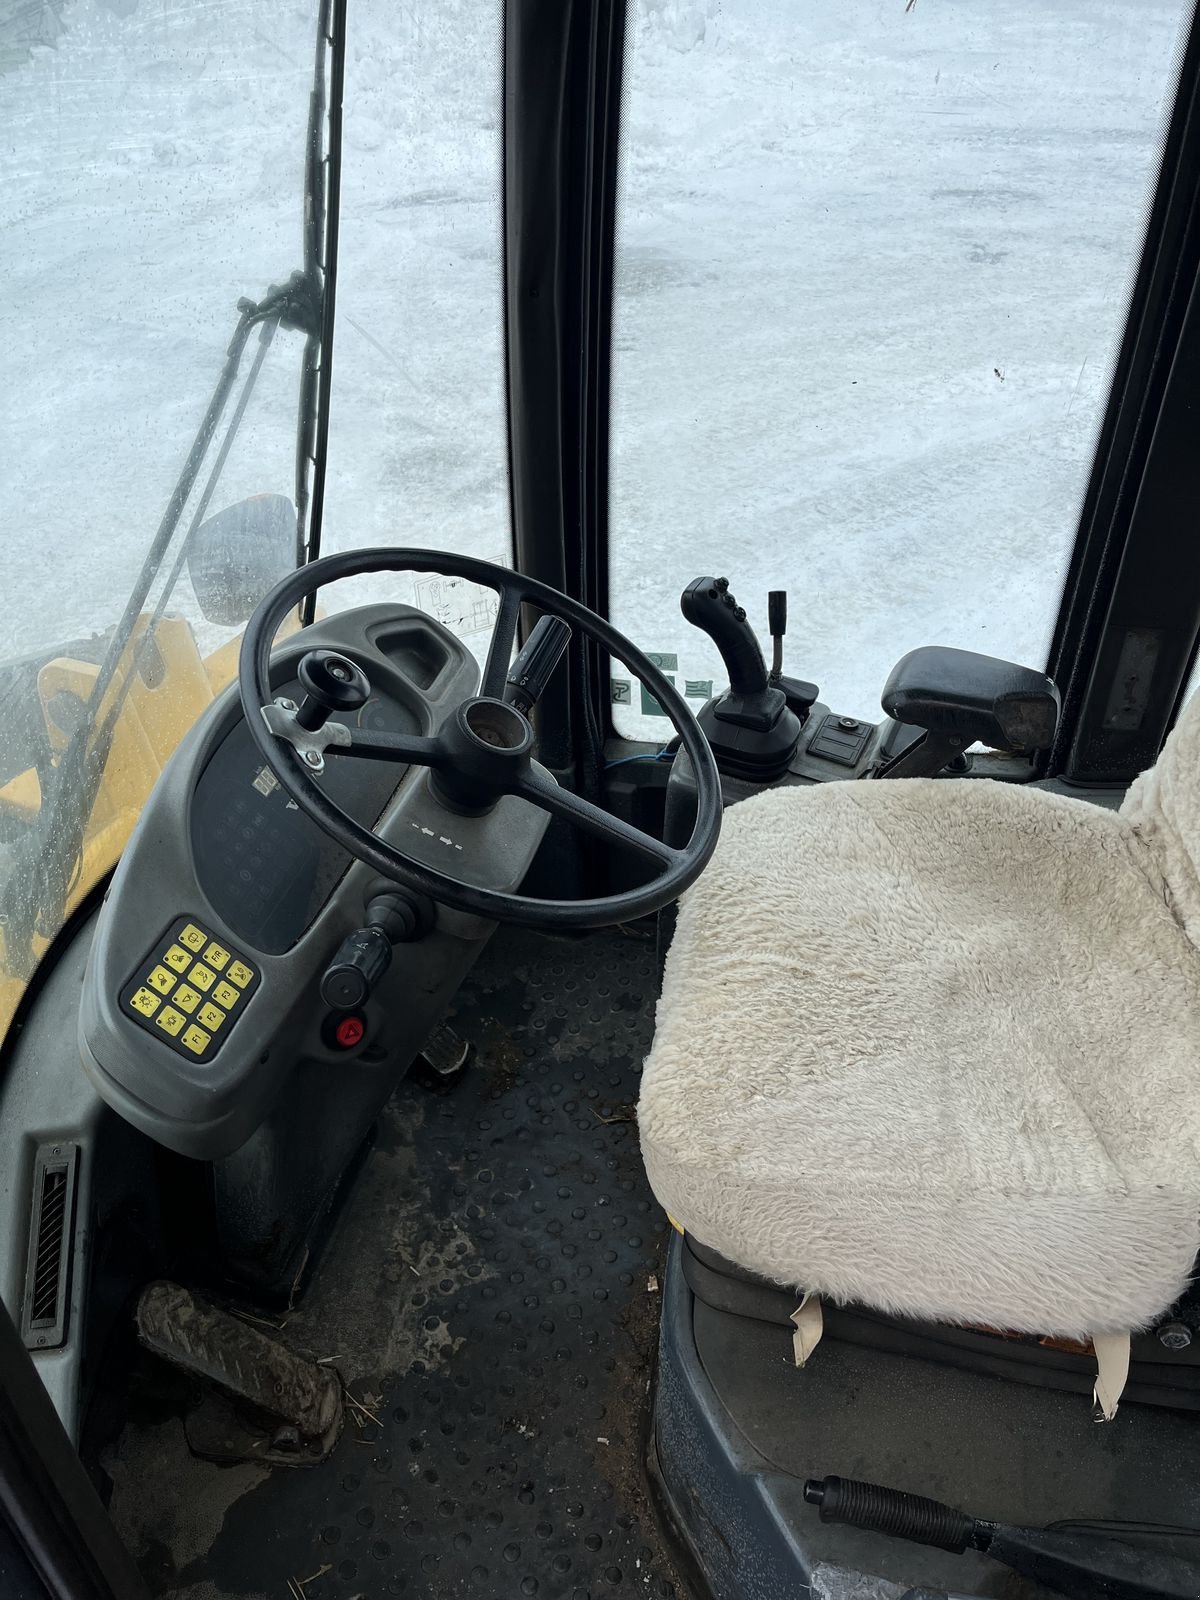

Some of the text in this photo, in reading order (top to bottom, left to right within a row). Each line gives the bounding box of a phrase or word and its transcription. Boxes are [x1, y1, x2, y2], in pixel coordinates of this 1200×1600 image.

[211, 950, 223, 962] F/R
[221, 990, 231, 1001] F3
[206, 1011, 217, 1022] F2
[192, 1034, 202, 1044] F1
